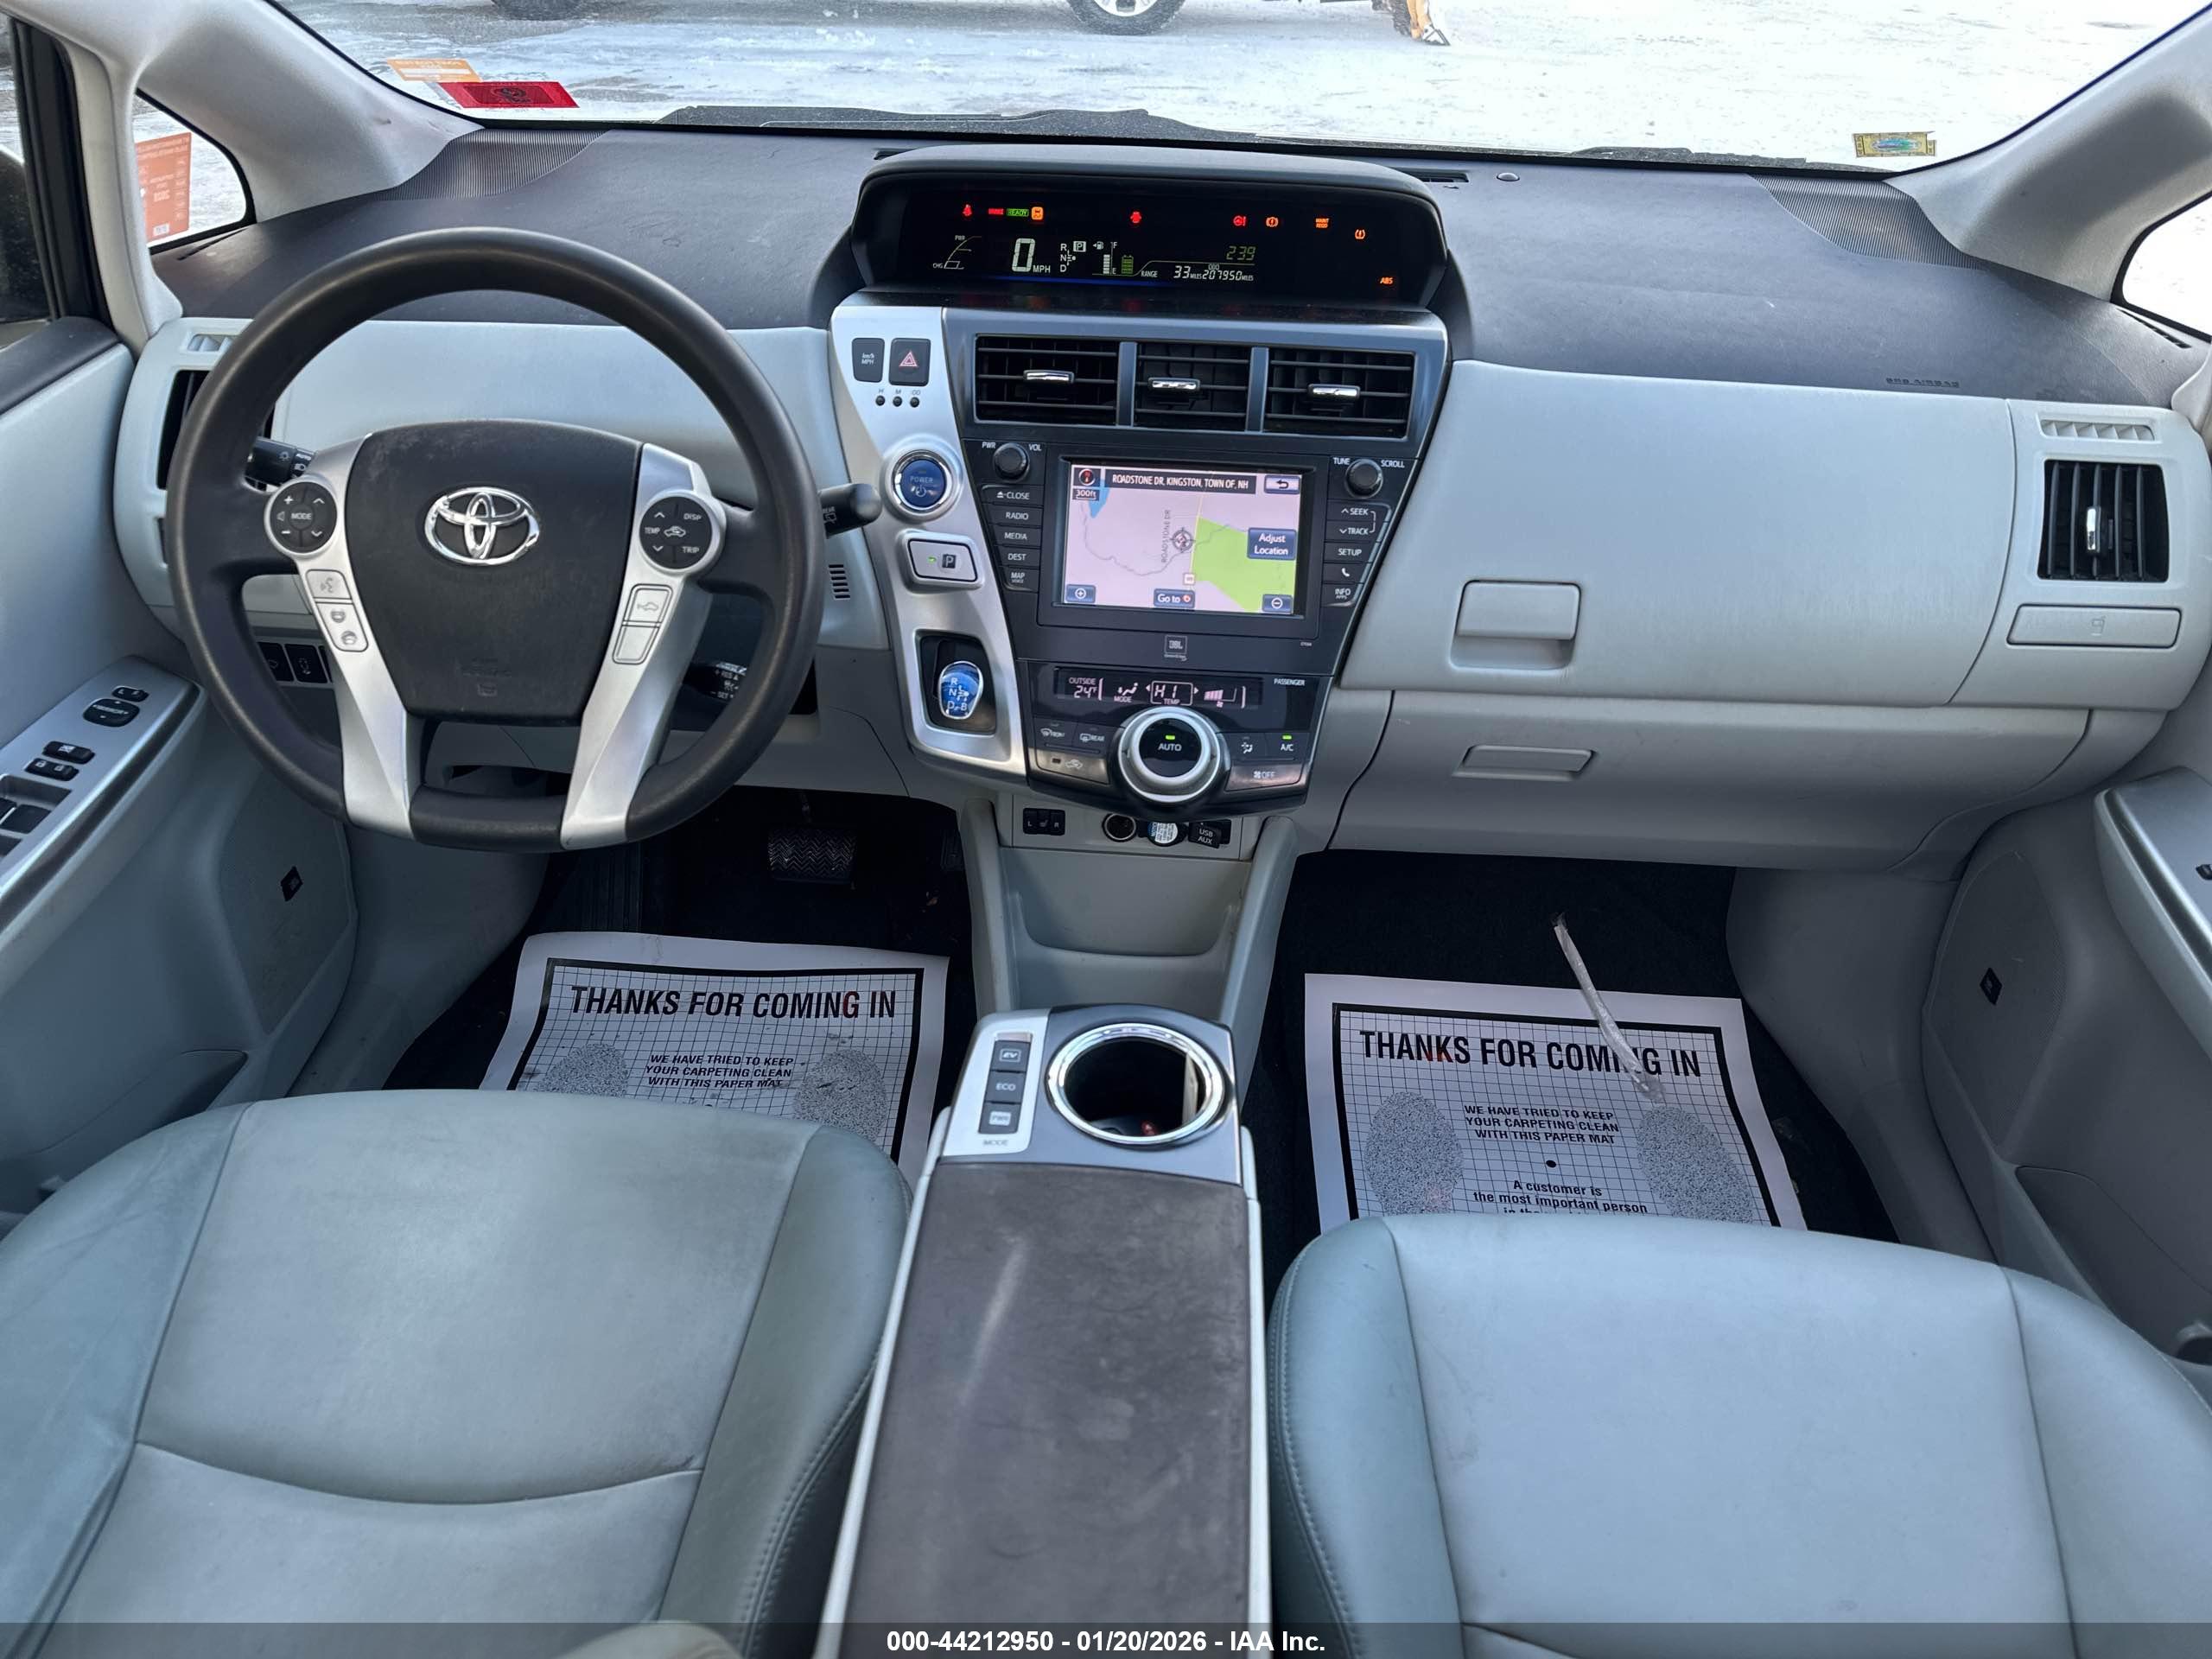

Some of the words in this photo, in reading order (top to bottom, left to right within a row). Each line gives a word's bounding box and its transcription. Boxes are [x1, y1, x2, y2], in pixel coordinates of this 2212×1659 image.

[1060, 243, 1067, 251] R
[1012, 238, 1036, 272] 0
[1226, 246, 1255, 260] 239
[1173, 265, 1191, 279] 33
[1202, 270, 1243, 281] 207950
[1381, 460, 1405, 468] SCROLL
[910, 475, 933, 484] POWER
[1112, 474, 1153, 486] ROADSTONE
[1166, 478, 1203, 488] KINGSTON,
[1205, 479, 1224, 489] TOWN
[683, 512, 702, 521] DISP
[1006, 512, 1029, 520] RADIO
[1004, 531, 1027, 540] MEDIA
[1258, 533, 1287, 546] Adjust
[1254, 546, 1288, 556] Location
[1157, 593, 1172, 603] Go
[1172, 594, 1181, 604] to
[947, 701, 955, 709] D
[960, 702, 968, 711] B
[1158, 742, 1182, 752] AUTO
[1281, 744, 1294, 753] A/C
[1198, 829, 1214, 838] USB
[1198, 836, 1213, 846] AUX
[570, 986, 681, 1016] THANKS
[689, 993, 744, 1018] FOR
[753, 991, 861, 1020] COMING
[869, 990, 896, 1019] IN
[1359, 1030, 1470, 1065] THANKS
[1481, 1038, 1537, 1068] FOR
[1671, 1050, 1701, 1077] IN
[650, 1055, 670, 1065] WE
[672, 1055, 703, 1065] HAVE
[707, 1055, 741, 1066] TRIED
[745, 1057, 761, 1066] TO
[764, 1058, 794, 1067] KEEP
[646, 1065, 679, 1076] YOUR
[683, 1067, 751, 1078] CARPETING
[753, 1069, 792, 1077] CLEAN
[648, 1077, 679, 1087] WITH
[683, 1078, 711, 1089] THIS
[715, 1080, 753, 1089] PAPER
[756, 1079, 783, 1089] MAT
[995, 1083, 1016, 1091] ECO
[1464, 1105, 1484, 1116] WE
[1487, 1107, 1520, 1116] HAVE
[1522, 1107, 1560, 1119] TRIED
[1563, 1109, 1580, 1119] TO
[1583, 1111, 1614, 1122] KEEP
[1465, 1116, 1501, 1128] YOUR
[1504, 1118, 1575, 1130] CARPETING
[1579, 1122, 1620, 1133] CLEAN
[1474, 1129, 1509, 1139] WITH
[1511, 1131, 1541, 1141] THIS
[1544, 1133, 1586, 1143] PAPER
[1588, 1134, 1616, 1144] MAT
[1513, 1180, 1522, 1191] A
[1526, 1182, 1587, 1196] customer
[1590, 1185, 1603, 1197] is
[1472, 1192, 1495, 1203] the
[1498, 1195, 1532, 1206] most
[1535, 1197, 1599, 1211] important
[1602, 1202, 1649, 1215] person
